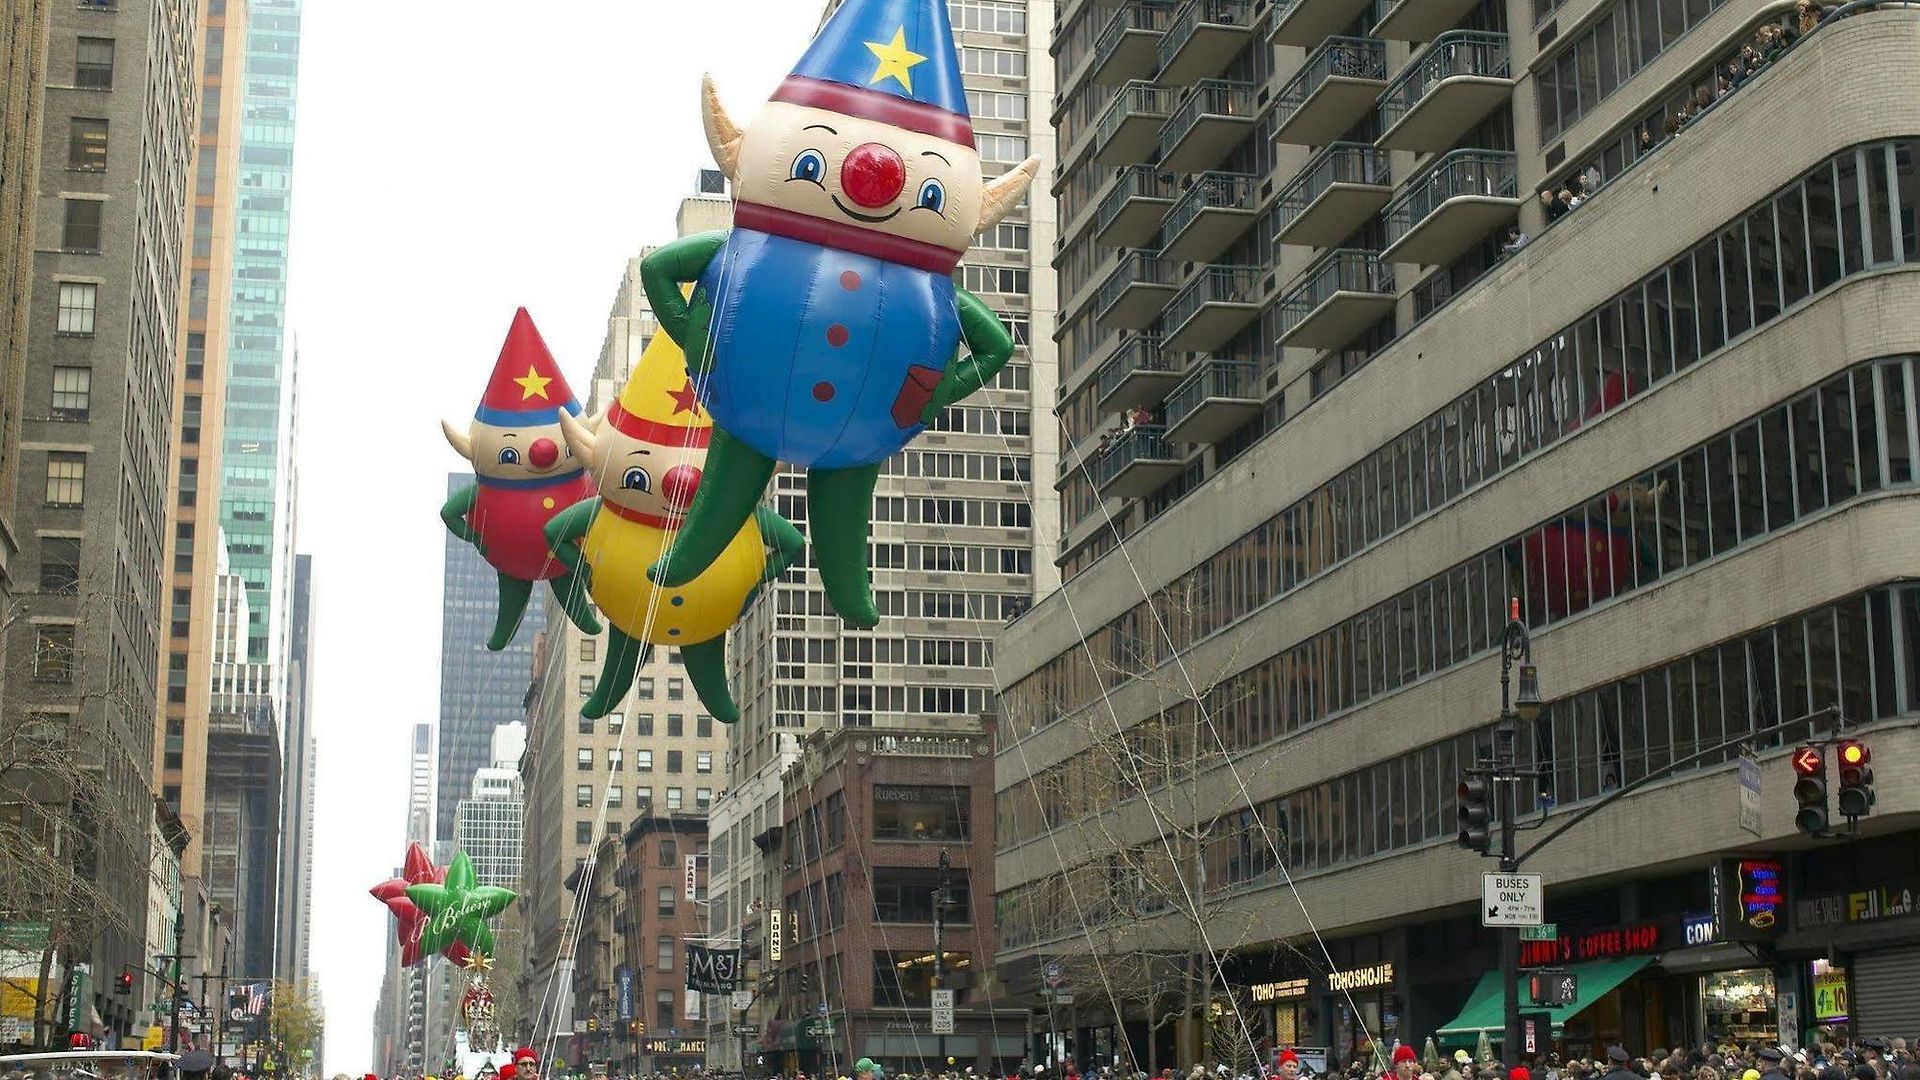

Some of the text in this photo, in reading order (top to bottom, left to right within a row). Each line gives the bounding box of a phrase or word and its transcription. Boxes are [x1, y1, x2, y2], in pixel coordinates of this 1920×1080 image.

[1496, 879, 1529, 889] BUSES
[1500, 892, 1525, 902] ONLY
[1537, 926, 1547, 938] 36
[1520, 925, 1657, 966] JIMMY'S COFFEE SHOP
[692, 953, 734, 980] M&J
[1328, 965, 1384, 991] TOHOSHOJI
[69, 975, 79, 1029] SHOES
[1251, 982, 1275, 1002] TOHO
